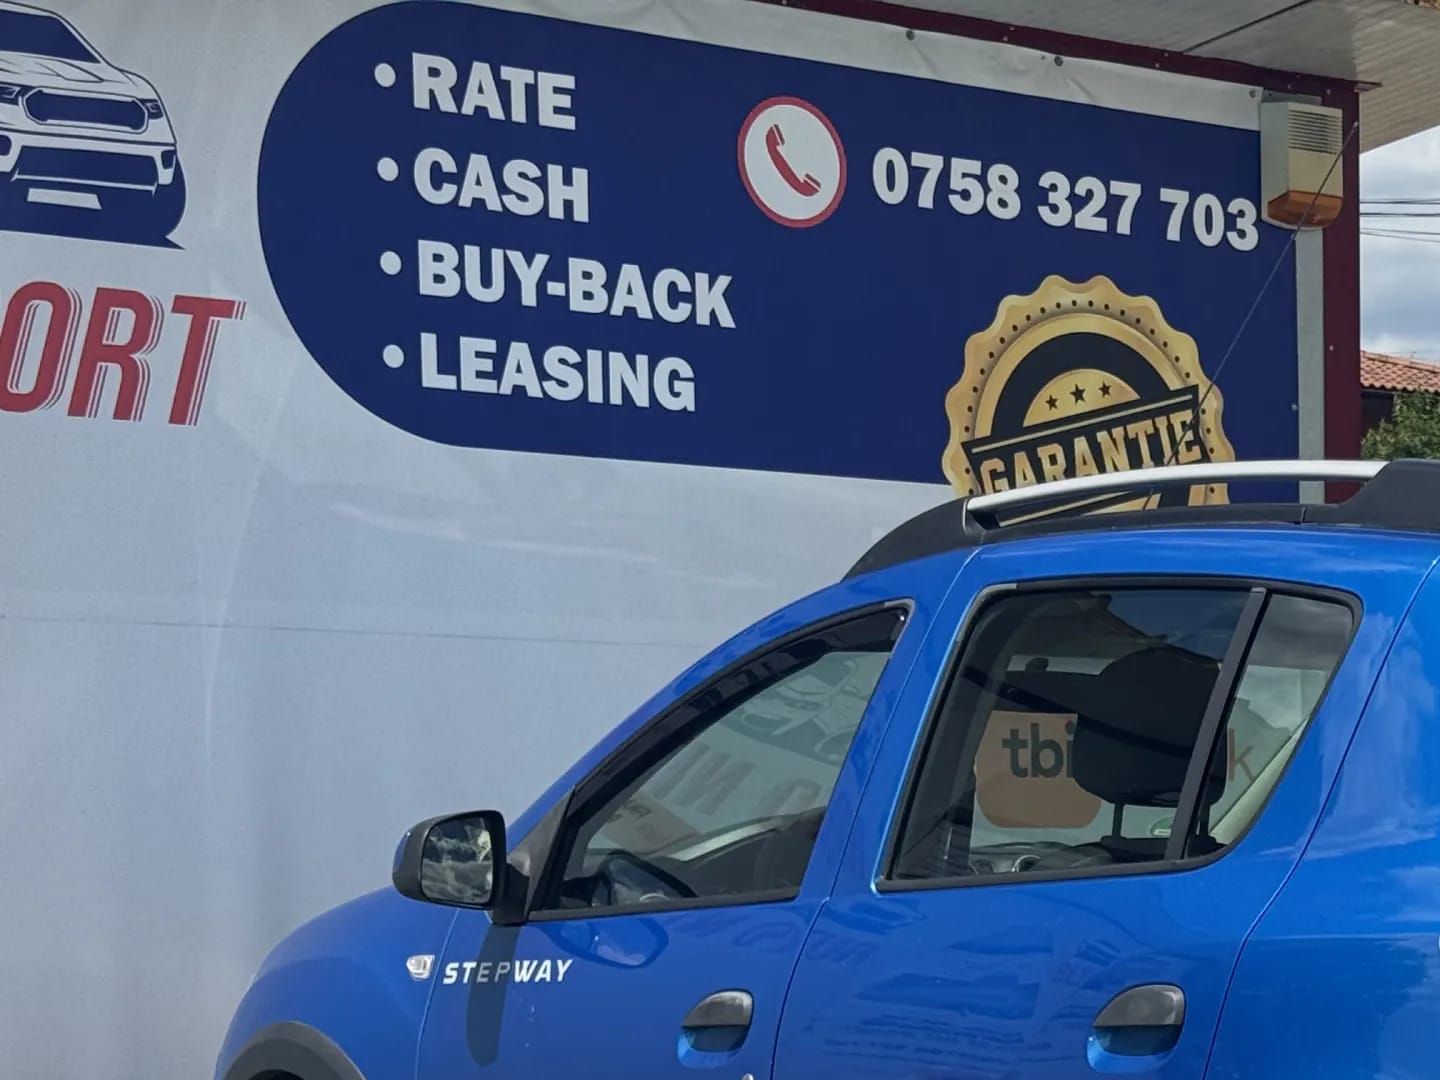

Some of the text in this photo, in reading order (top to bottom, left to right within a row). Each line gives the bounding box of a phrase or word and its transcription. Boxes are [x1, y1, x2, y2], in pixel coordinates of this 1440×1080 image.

[411, 52, 577, 131] RATE
[413, 147, 590, 223] CASH
[872, 147, 1259, 252] 0758 327 703
[417, 239, 736, 328] BUY-BACK
[420, 333, 696, 412] LEASING
[979, 408, 1202, 493] GARANTIE
[442, 959, 573, 985] STEPWAY
